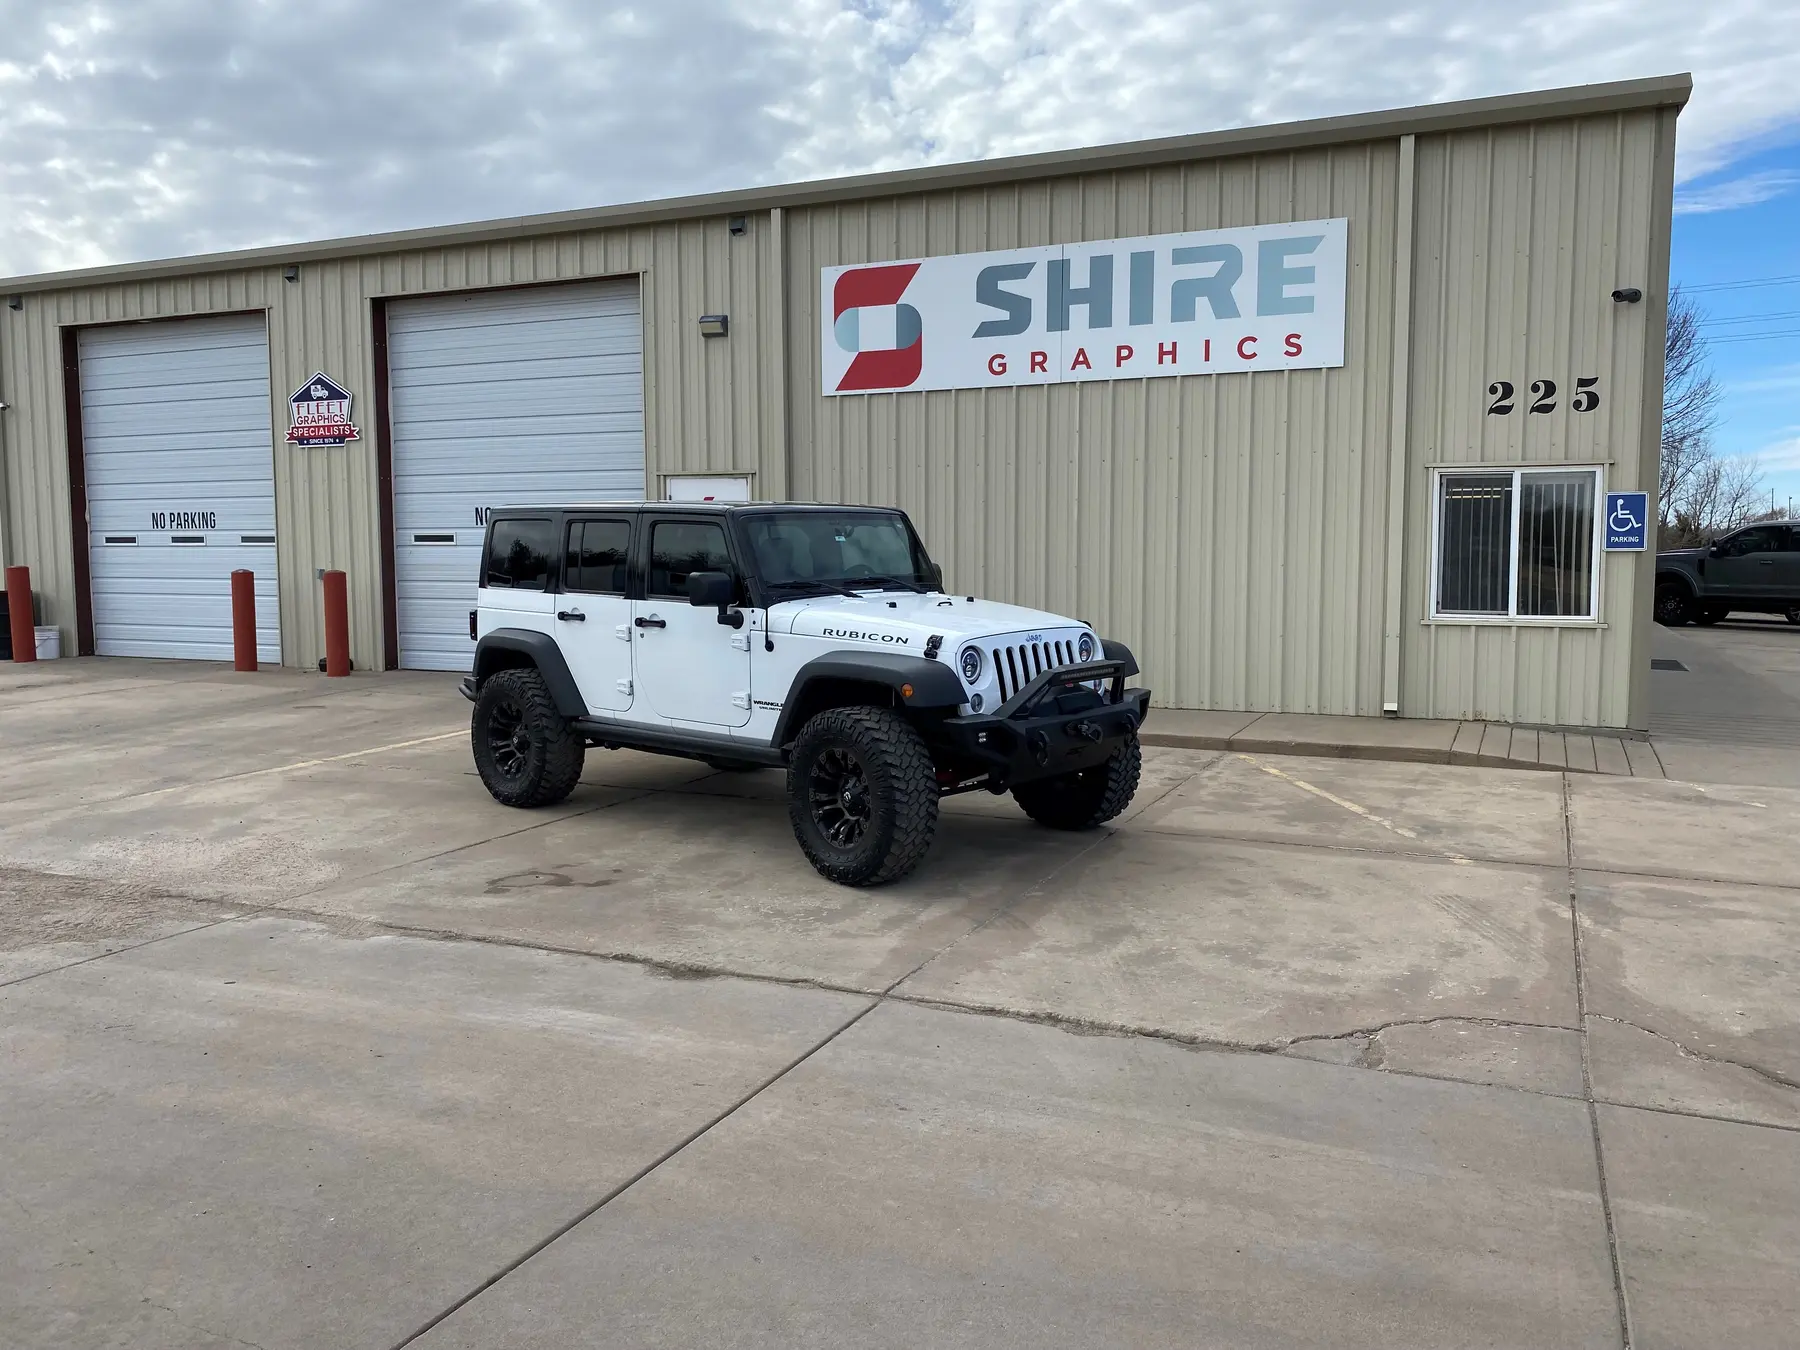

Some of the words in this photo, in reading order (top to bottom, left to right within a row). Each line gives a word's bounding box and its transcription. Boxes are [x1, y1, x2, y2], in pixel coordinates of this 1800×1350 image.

[972, 235, 1326, 338] SHIRE
[987, 333, 1303, 376] GRAPHICS
[1487, 377, 1600, 416] 225
[296, 400, 345, 415] FLEET
[296, 413, 345, 425] GRAPHICS
[292, 426, 350, 437] SPECIALISTS
[152, 512, 166, 529] NO
[169, 512, 216, 529] PARKING
[822, 628, 909, 644] RUBICON
